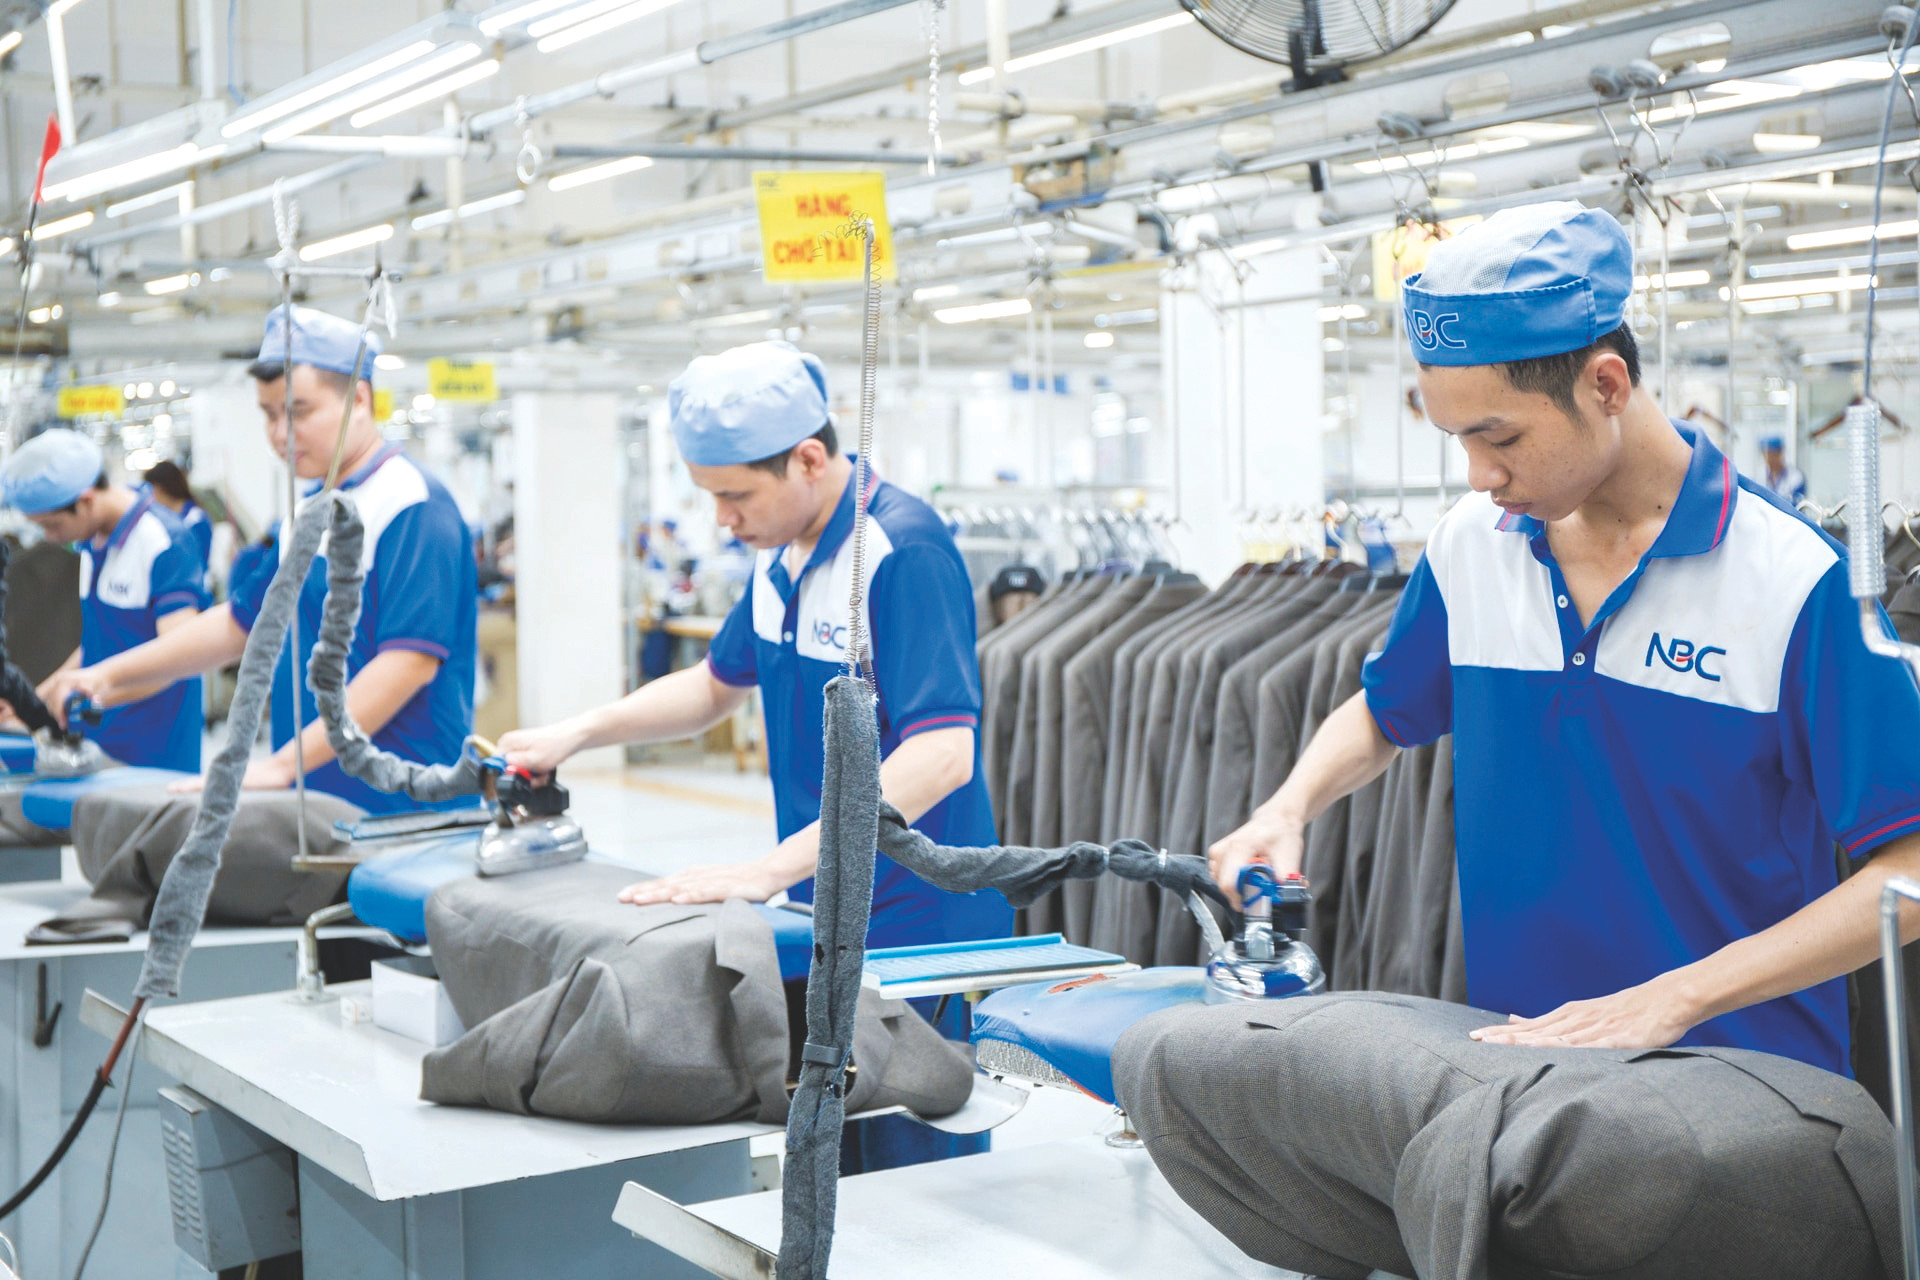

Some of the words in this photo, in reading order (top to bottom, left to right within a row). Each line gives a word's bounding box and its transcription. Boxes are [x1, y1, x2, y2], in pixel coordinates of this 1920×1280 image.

[1403, 308, 1467, 350] NBC
[811, 618, 847, 650] NBC
[1645, 632, 1727, 682] NBC
